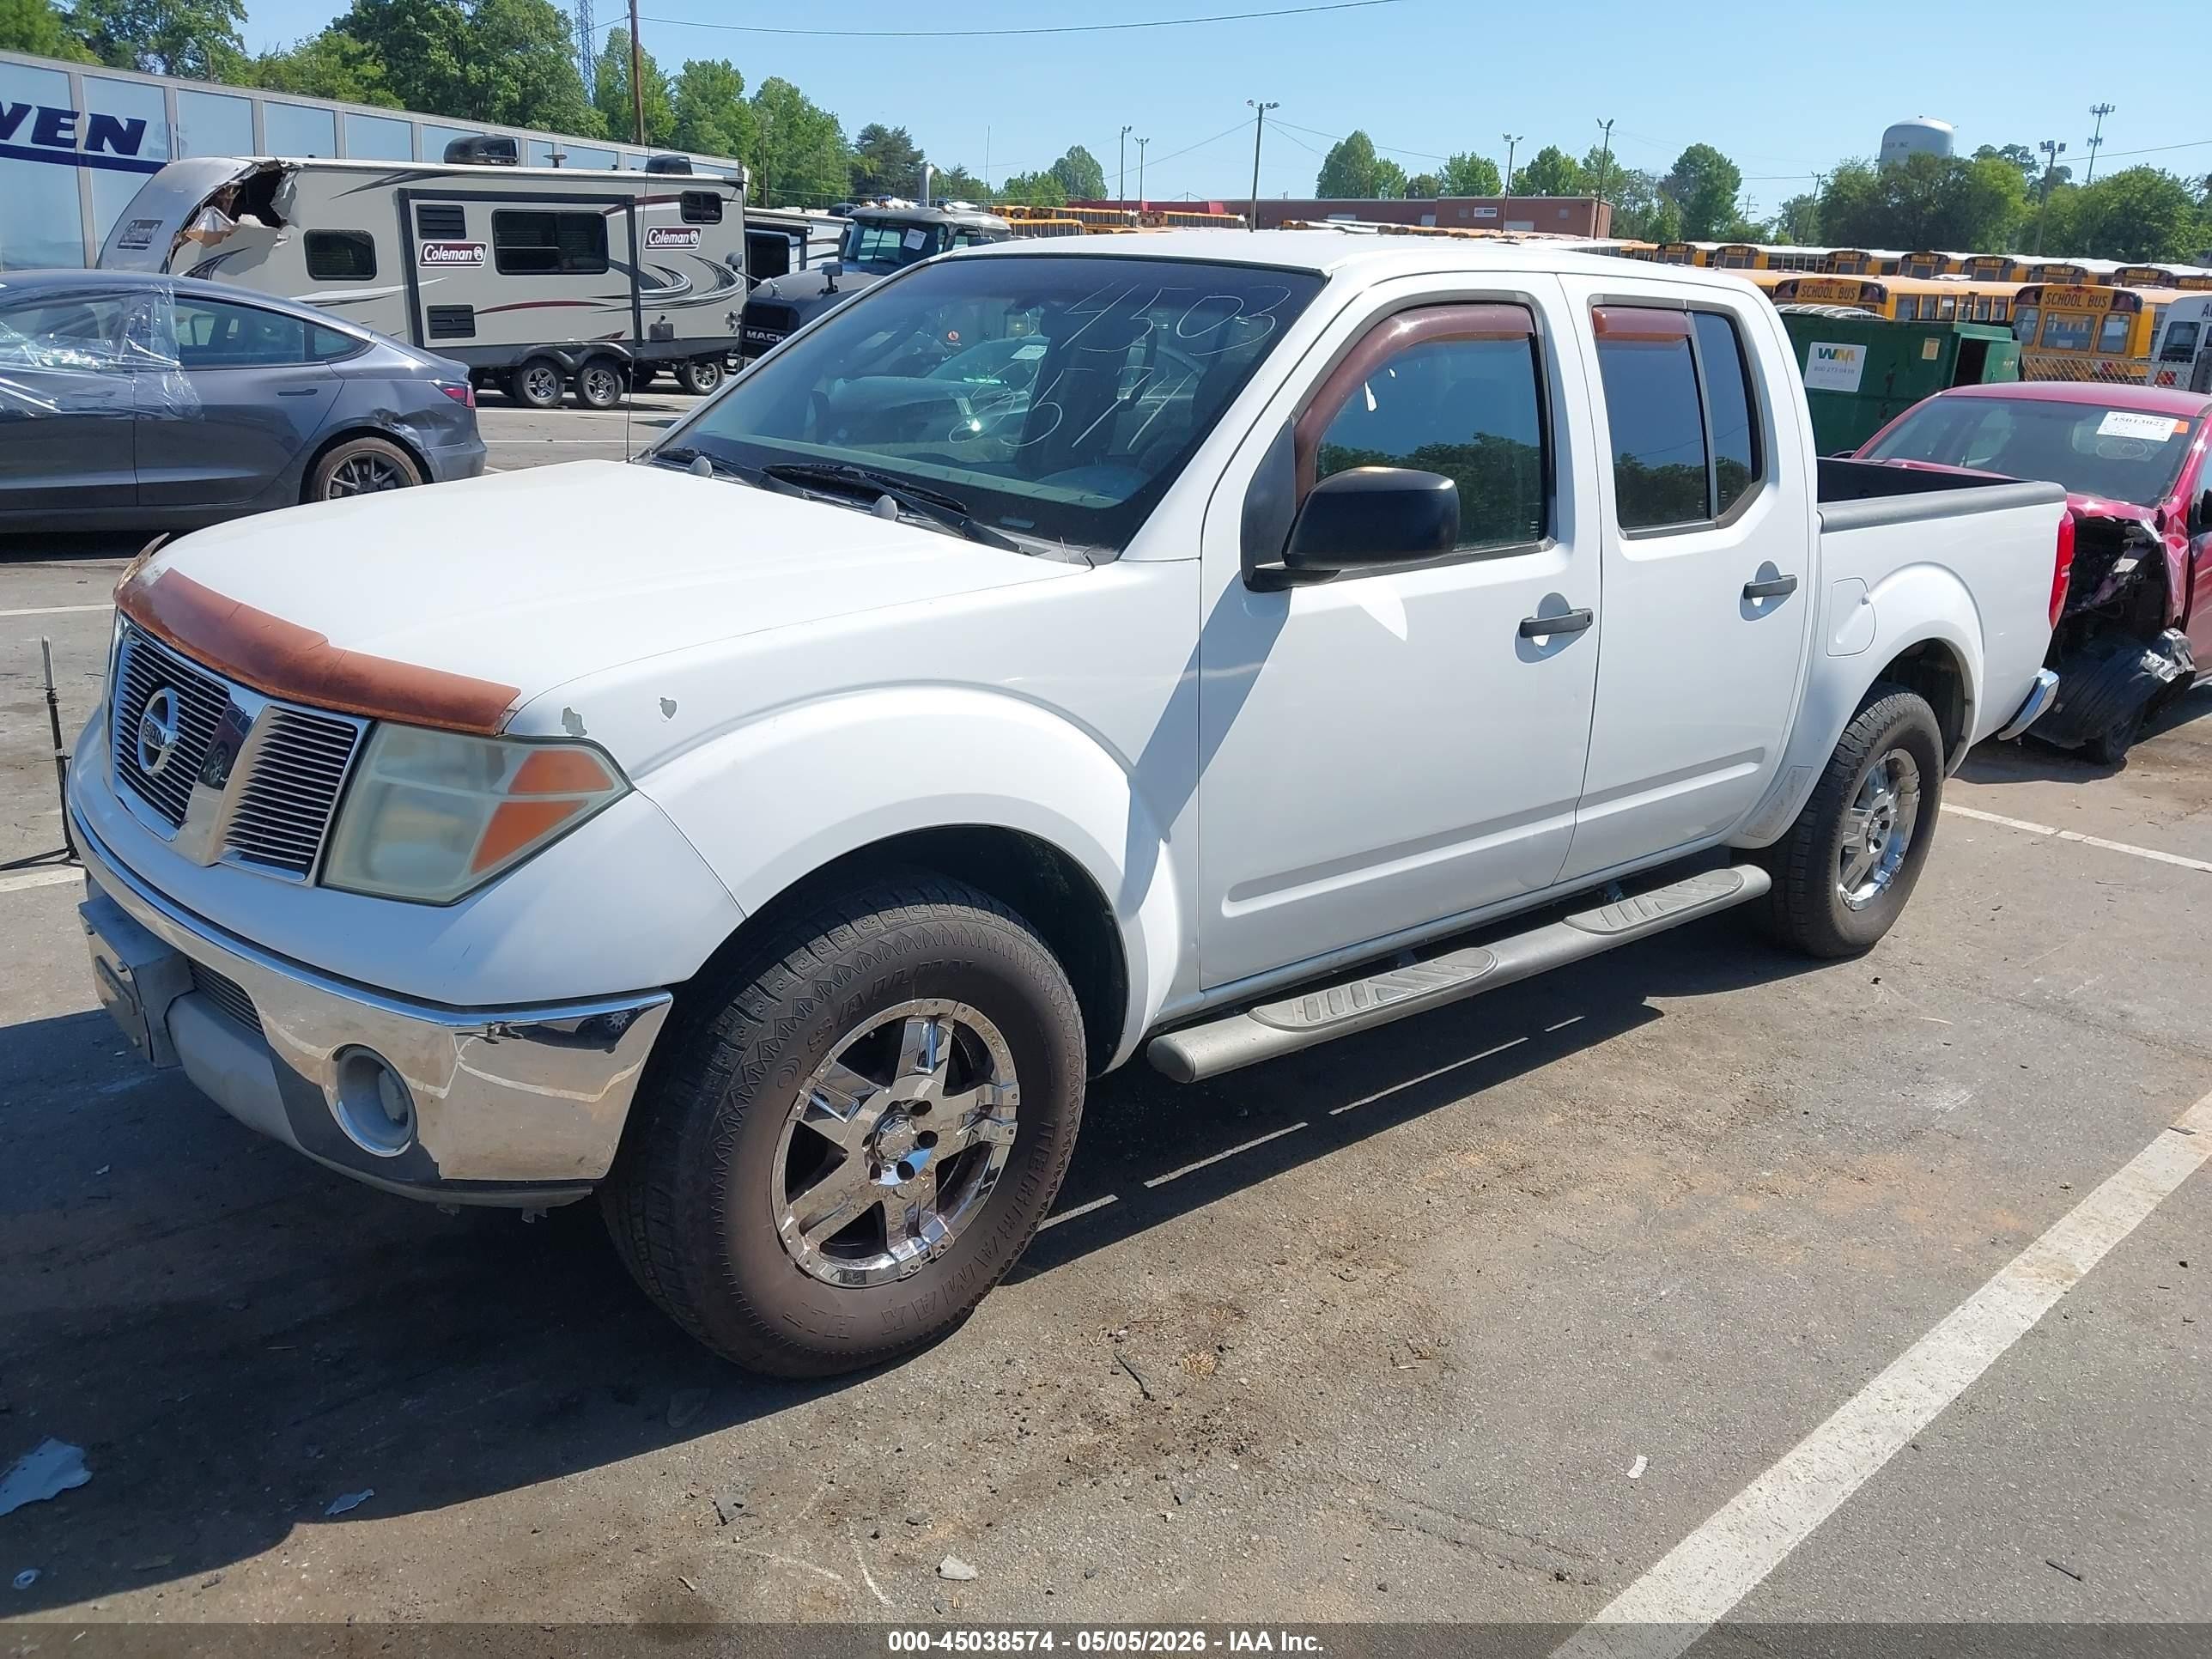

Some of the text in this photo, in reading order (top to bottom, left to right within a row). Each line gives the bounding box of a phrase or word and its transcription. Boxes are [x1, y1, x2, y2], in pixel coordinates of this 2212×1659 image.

[648, 229, 690, 245] Coleman
[423, 244, 472, 261] Coleman
[1801, 285, 1856, 301] SCHOOL BUS
[2045, 293, 2107, 308] SCHOOL BUS
[1060, 281, 1291, 356] 4503
[746, 330, 785, 343] MACK
[1818, 348, 1855, 361] WM
